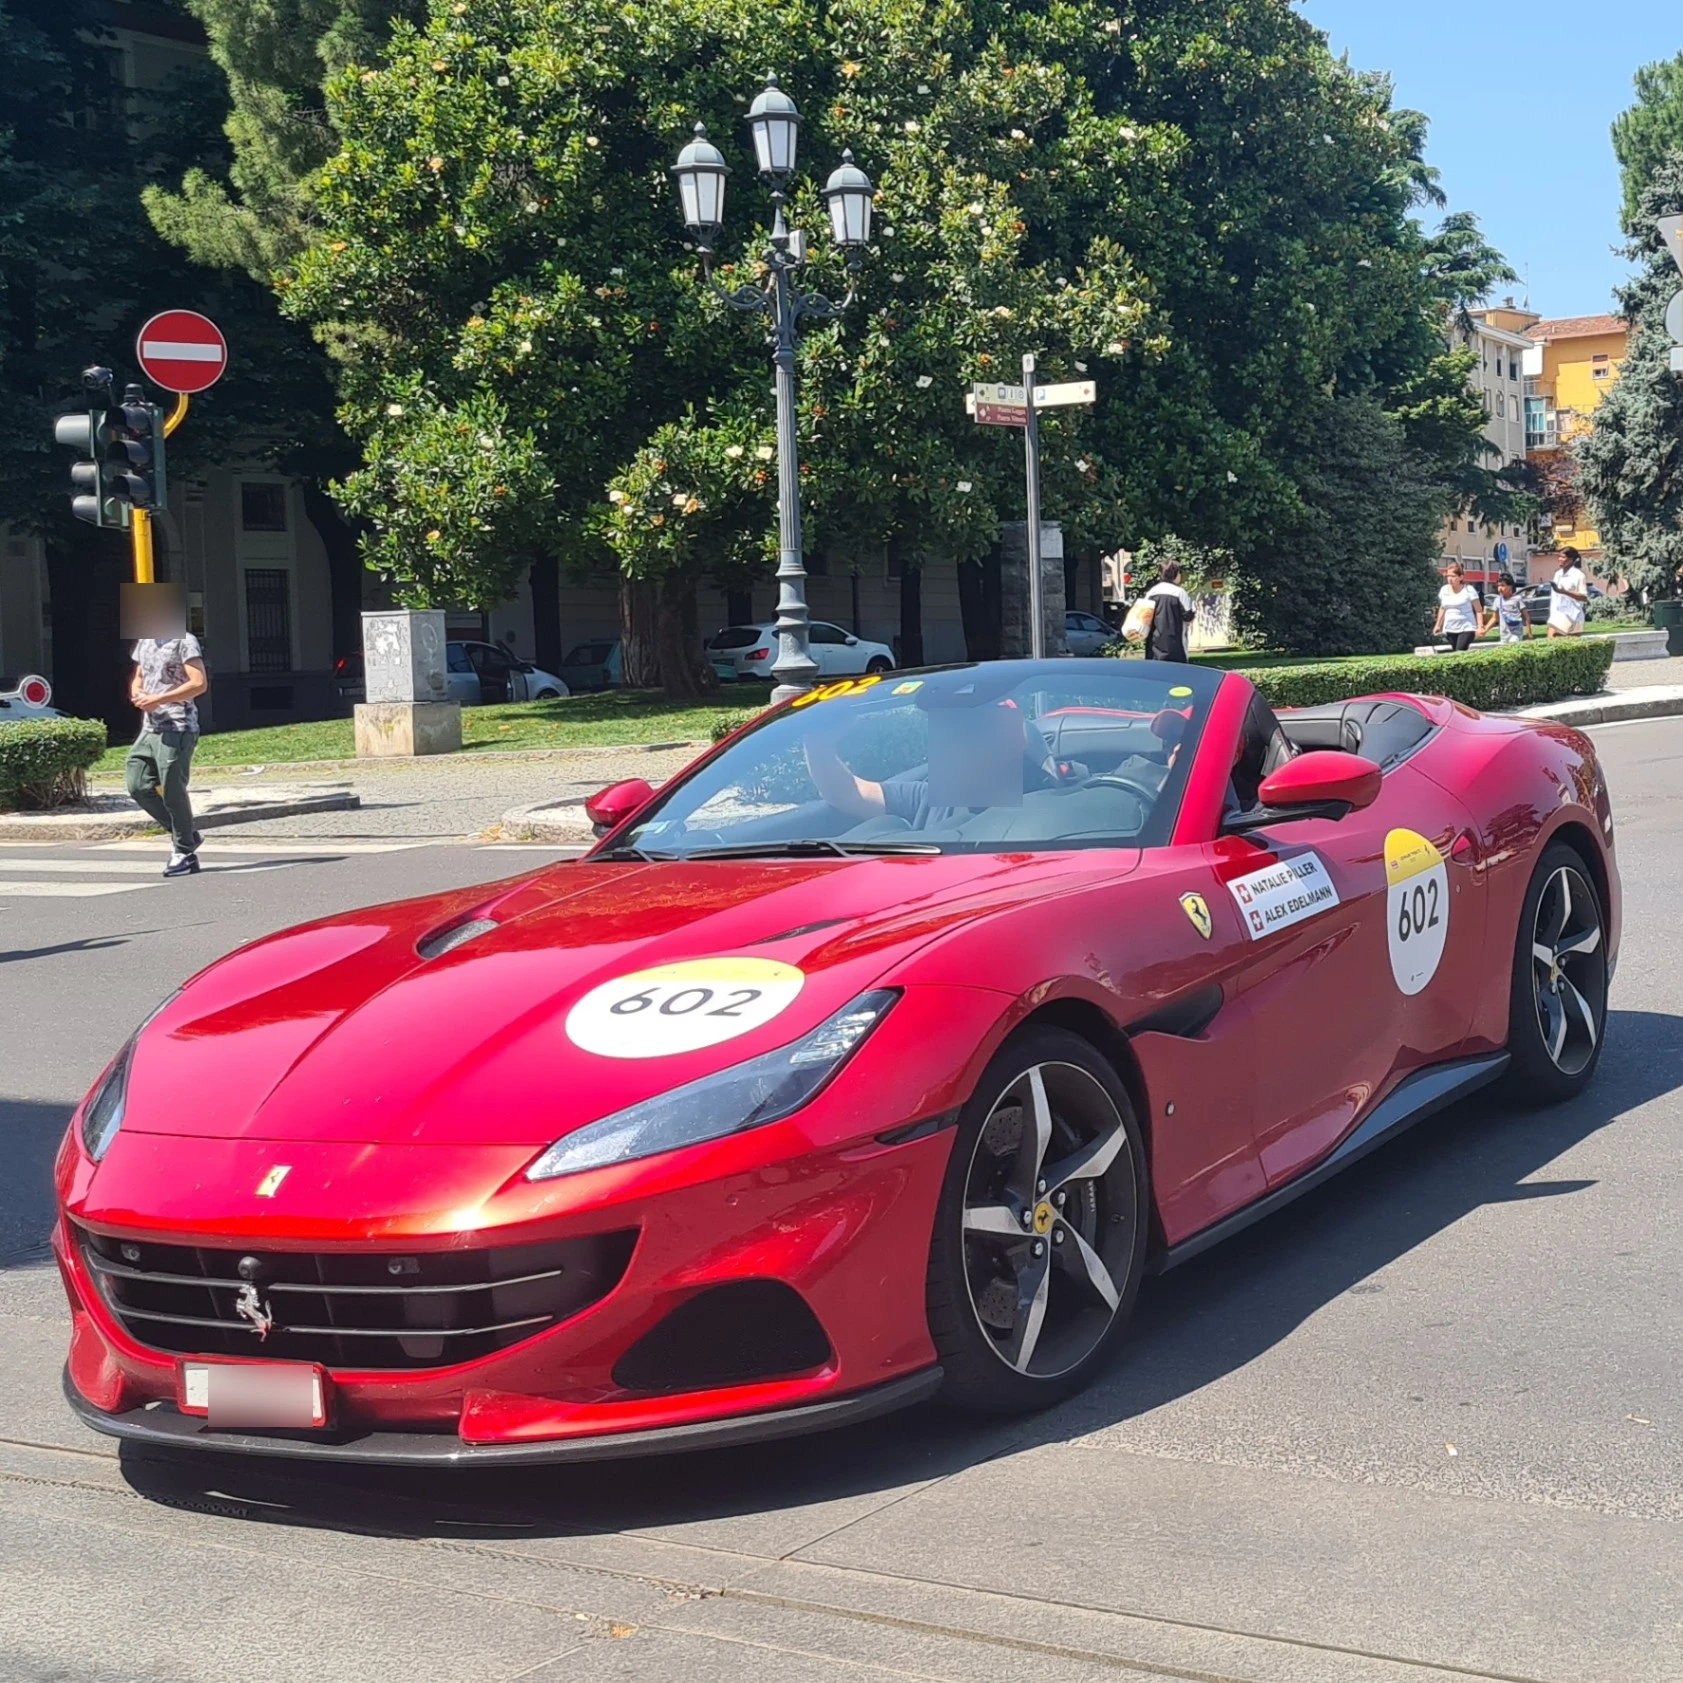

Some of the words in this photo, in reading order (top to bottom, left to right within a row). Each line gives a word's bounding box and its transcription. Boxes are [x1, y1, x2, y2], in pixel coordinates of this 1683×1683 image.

[792, 676, 882, 707] 602
[1250, 872, 1289, 896] NATALIE
[1286, 861, 1318, 881] PILLER
[1264, 903, 1289, 924] ALEX
[1287, 885, 1333, 914] EDELMANN
[1398, 878, 1439, 942] 602
[609, 987, 762, 1017] 602
